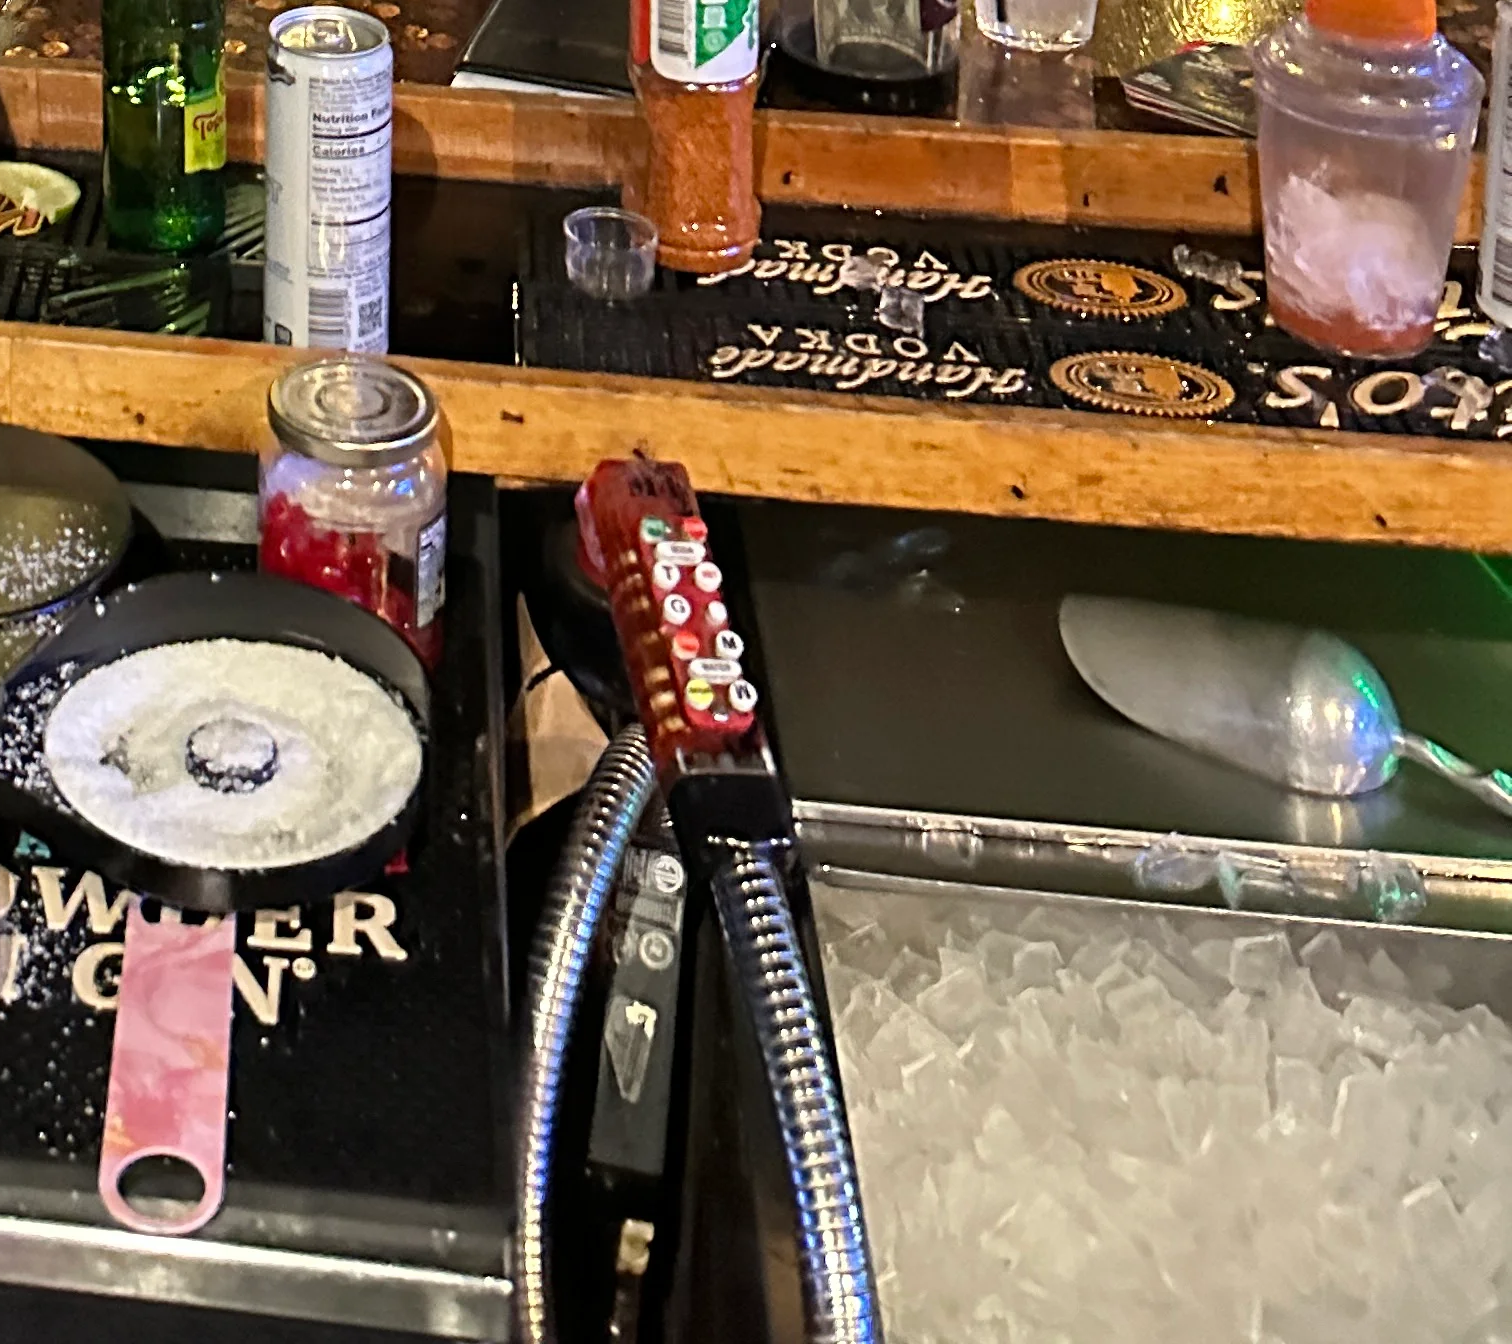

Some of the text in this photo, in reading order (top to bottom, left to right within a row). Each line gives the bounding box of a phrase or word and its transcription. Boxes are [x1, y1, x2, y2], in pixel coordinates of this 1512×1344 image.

[313, 112, 369, 124] Nutrition
[313, 145, 366, 157] Calories
[747, 322, 981, 363] VODKA
[710, 344, 1027, 399] Handmade
[670, 597, 686, 617] G
[721, 634, 737, 649] M
